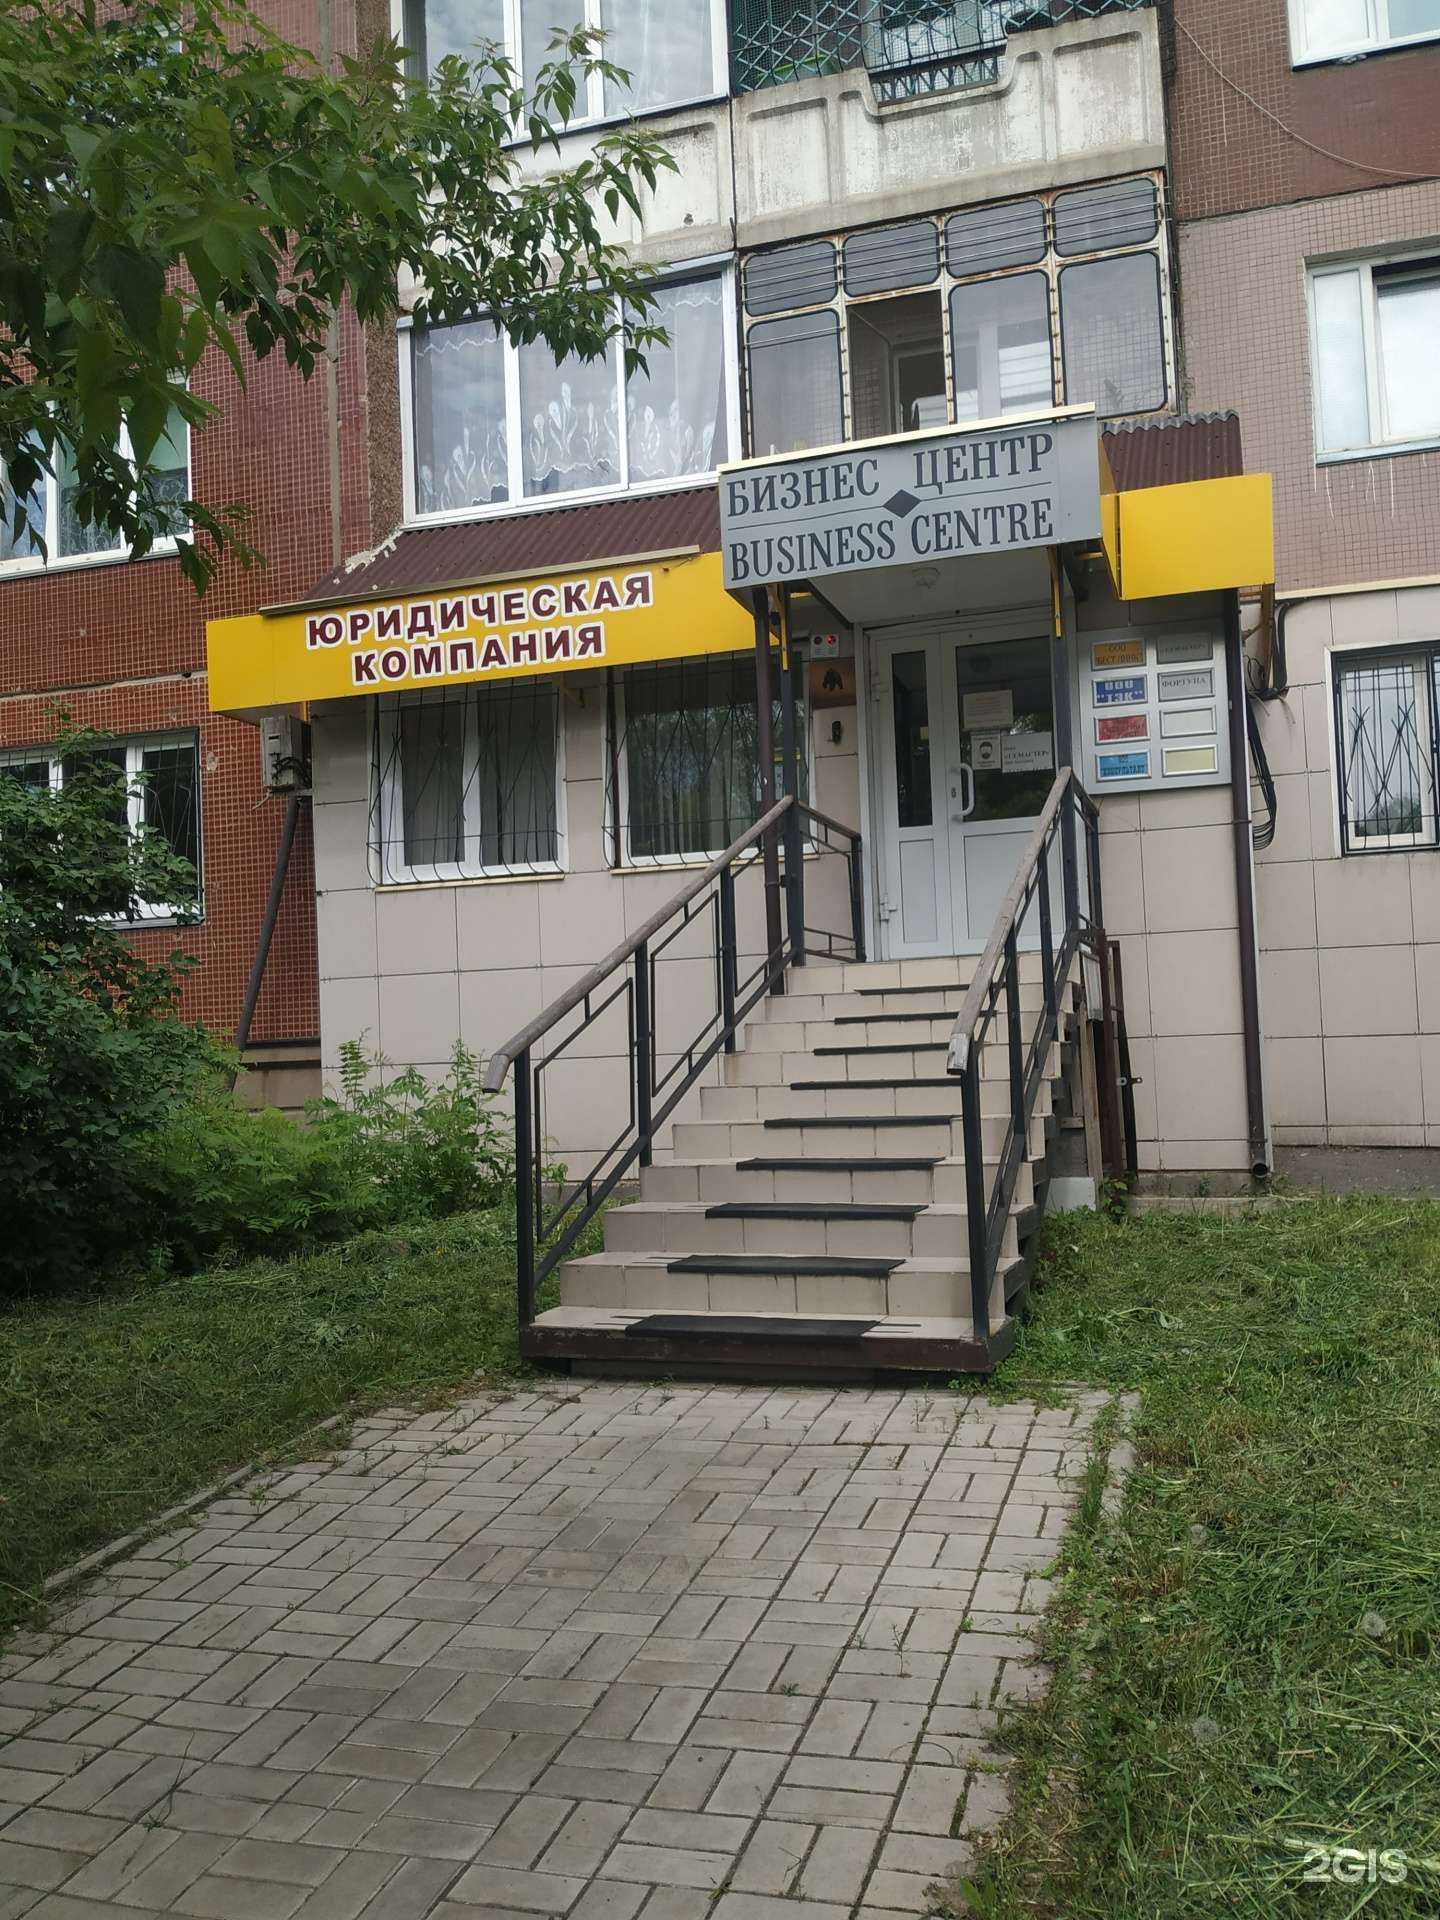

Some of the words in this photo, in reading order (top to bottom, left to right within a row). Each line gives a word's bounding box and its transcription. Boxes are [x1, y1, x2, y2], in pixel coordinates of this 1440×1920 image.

[727, 458, 880, 518] БИЗНЕС
[913, 433, 1053, 494] ЦЕНТР
[729, 519, 897, 582] BUSINESS
[911, 498, 1054, 556] CENTRE
[307, 573, 652, 648] ЮРИДИЧЕСКАЯ
[353, 623, 604, 684] КОМПАНИЯ
